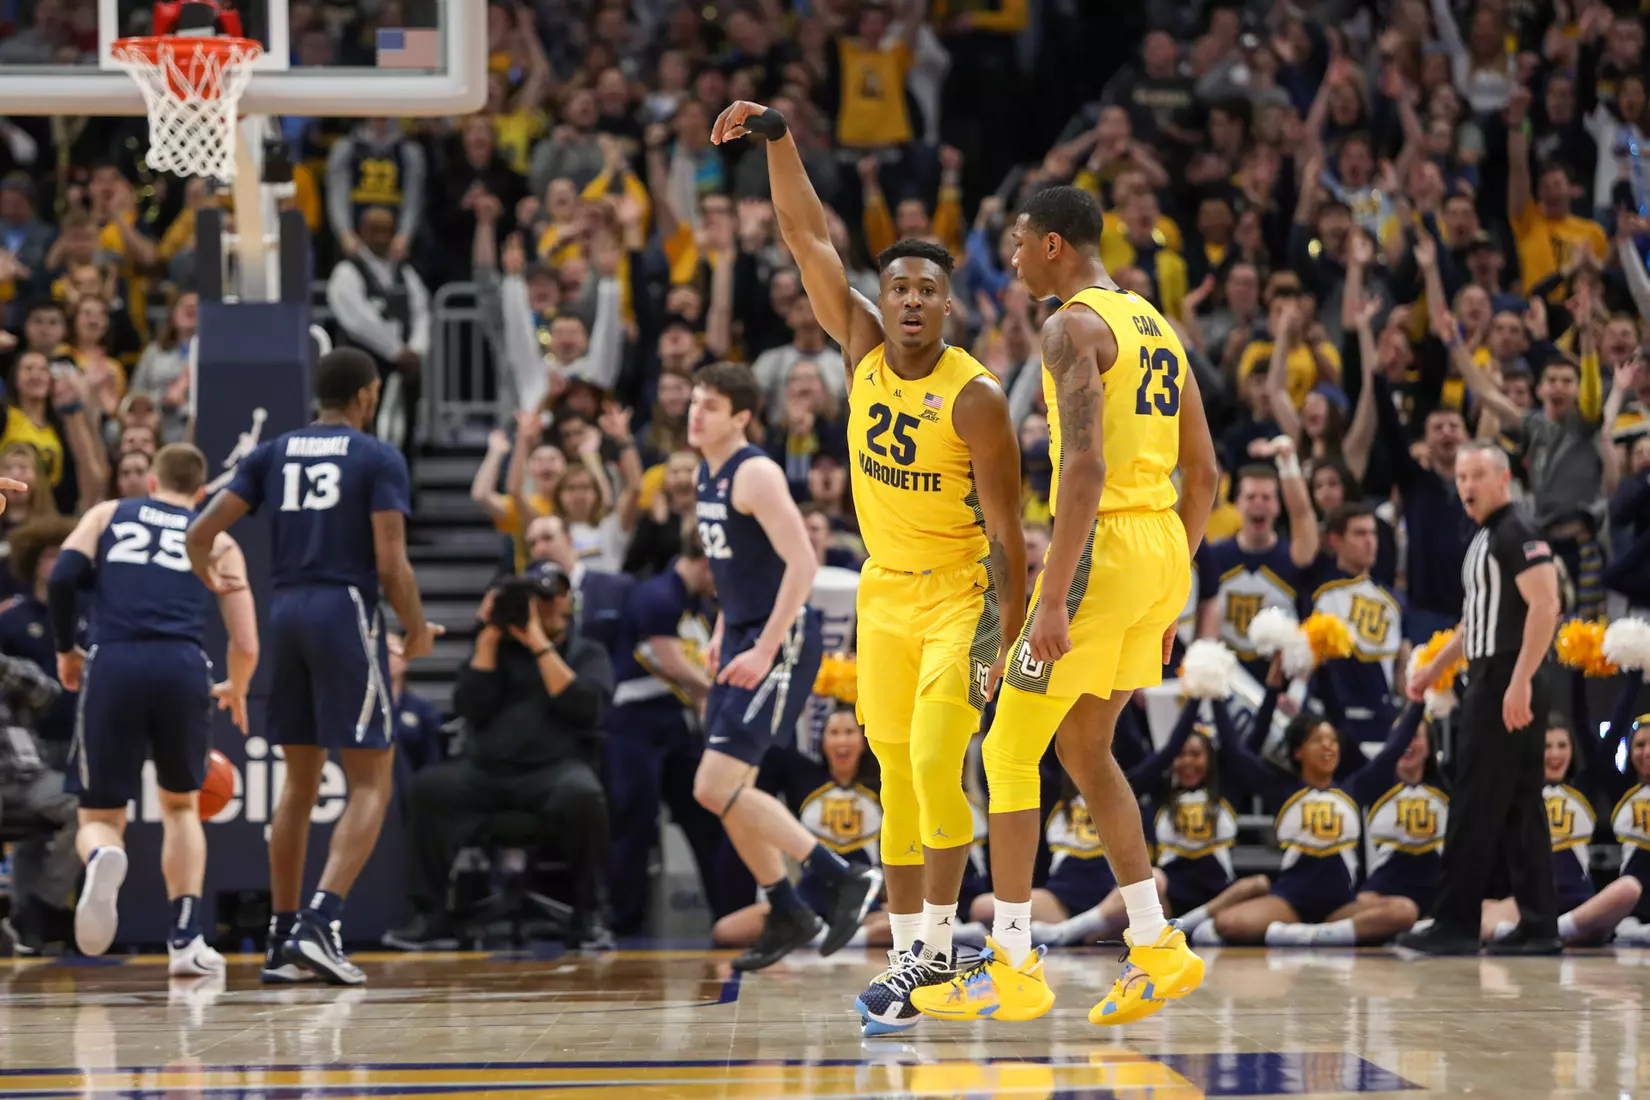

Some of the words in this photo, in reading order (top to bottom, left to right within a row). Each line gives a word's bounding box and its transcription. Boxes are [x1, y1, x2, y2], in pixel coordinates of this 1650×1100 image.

[1132, 316, 1162, 337] CAIN
[1135, 345, 1180, 417] 23
[866, 402, 921, 467] 25
[280, 462, 341, 512] 13
[107, 521, 193, 572] 25
[821, 798, 864, 838] MU
[1302, 800, 1344, 840] MU
[1396, 798, 1437, 838] MU
